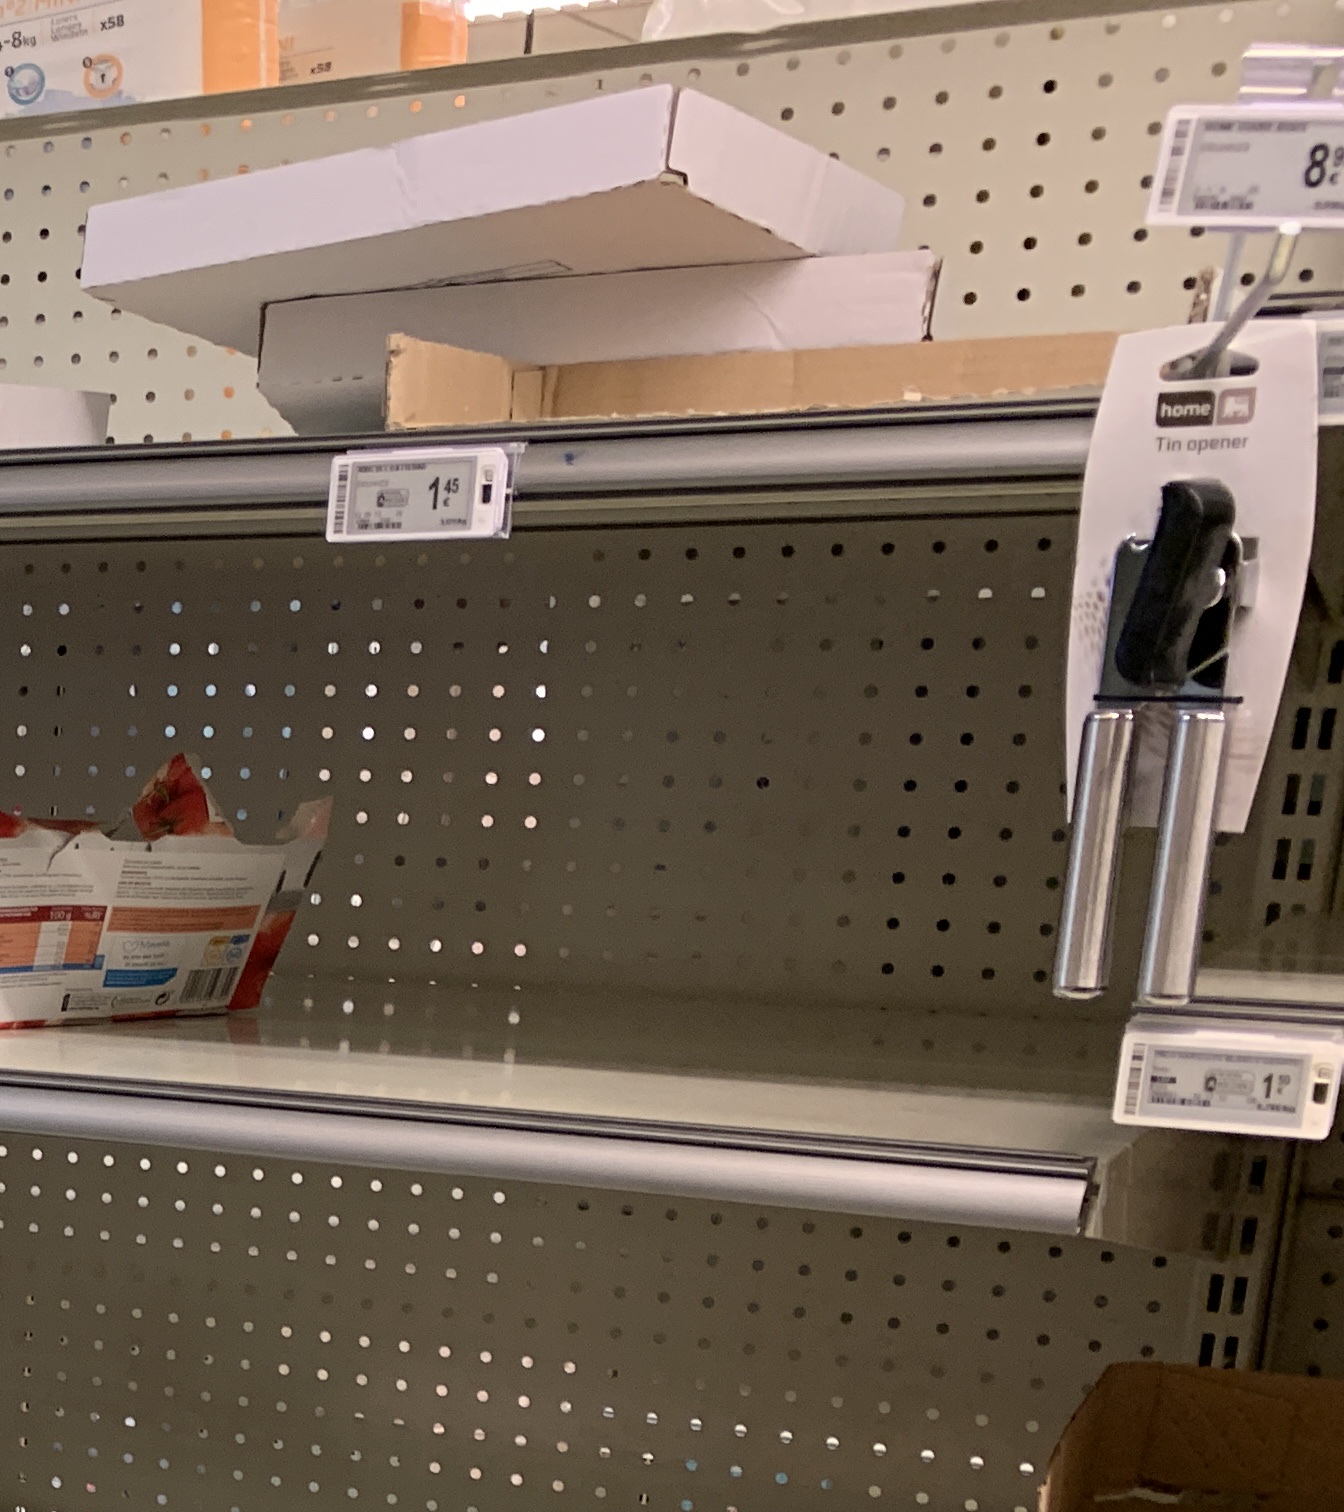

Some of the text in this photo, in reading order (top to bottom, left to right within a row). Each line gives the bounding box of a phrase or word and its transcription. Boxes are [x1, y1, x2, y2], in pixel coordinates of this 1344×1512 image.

[1160, 402, 1211, 418] home
[1156, 436, 1249, 455] Tin opener
